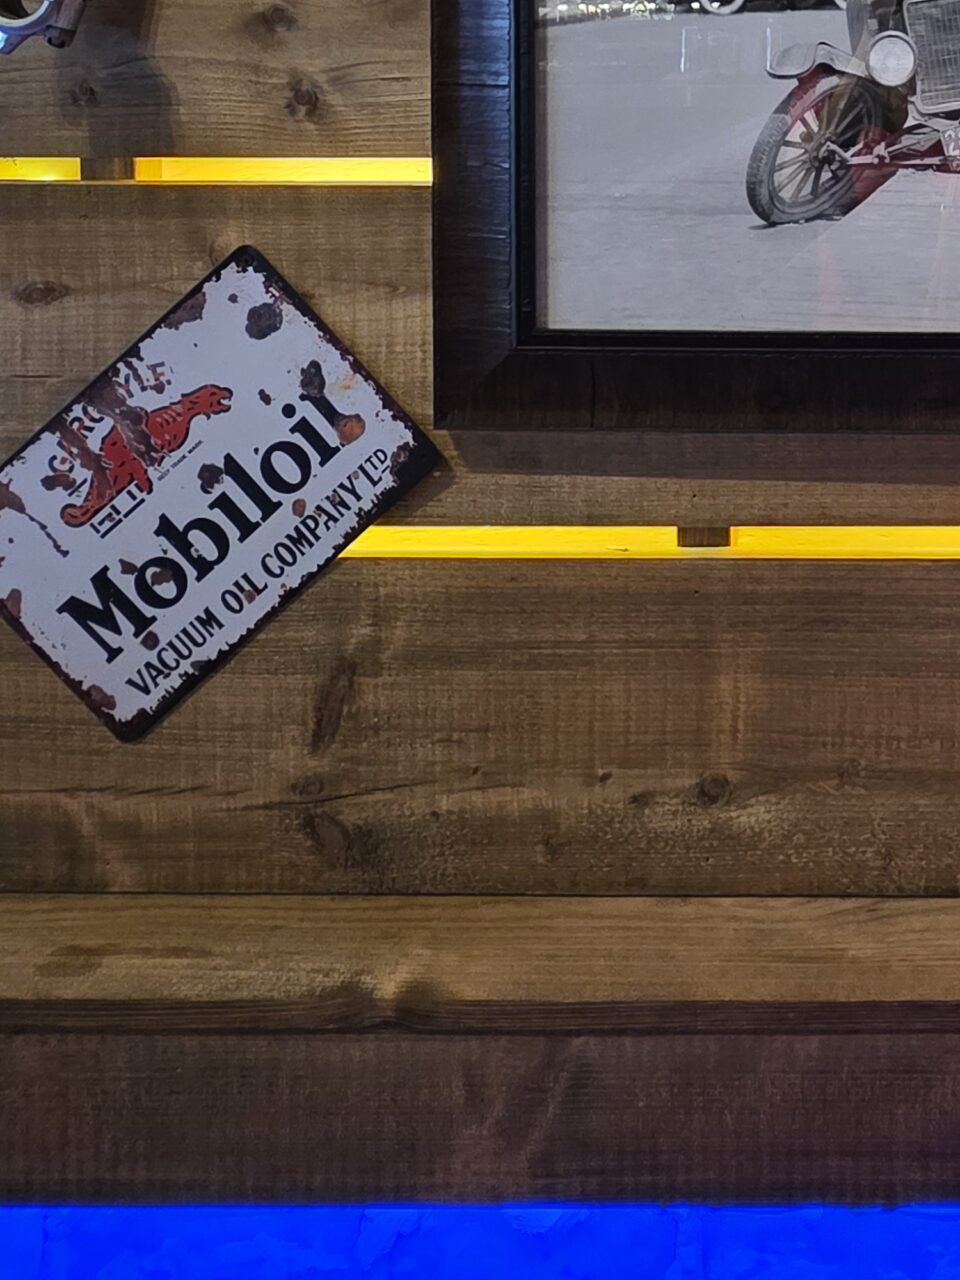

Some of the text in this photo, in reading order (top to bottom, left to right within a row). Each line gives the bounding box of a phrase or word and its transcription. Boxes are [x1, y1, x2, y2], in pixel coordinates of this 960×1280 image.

[56, 392, 354, 664] Mobiloil
[124, 448, 390, 696] VACUUM OIL COMPANY LTD
